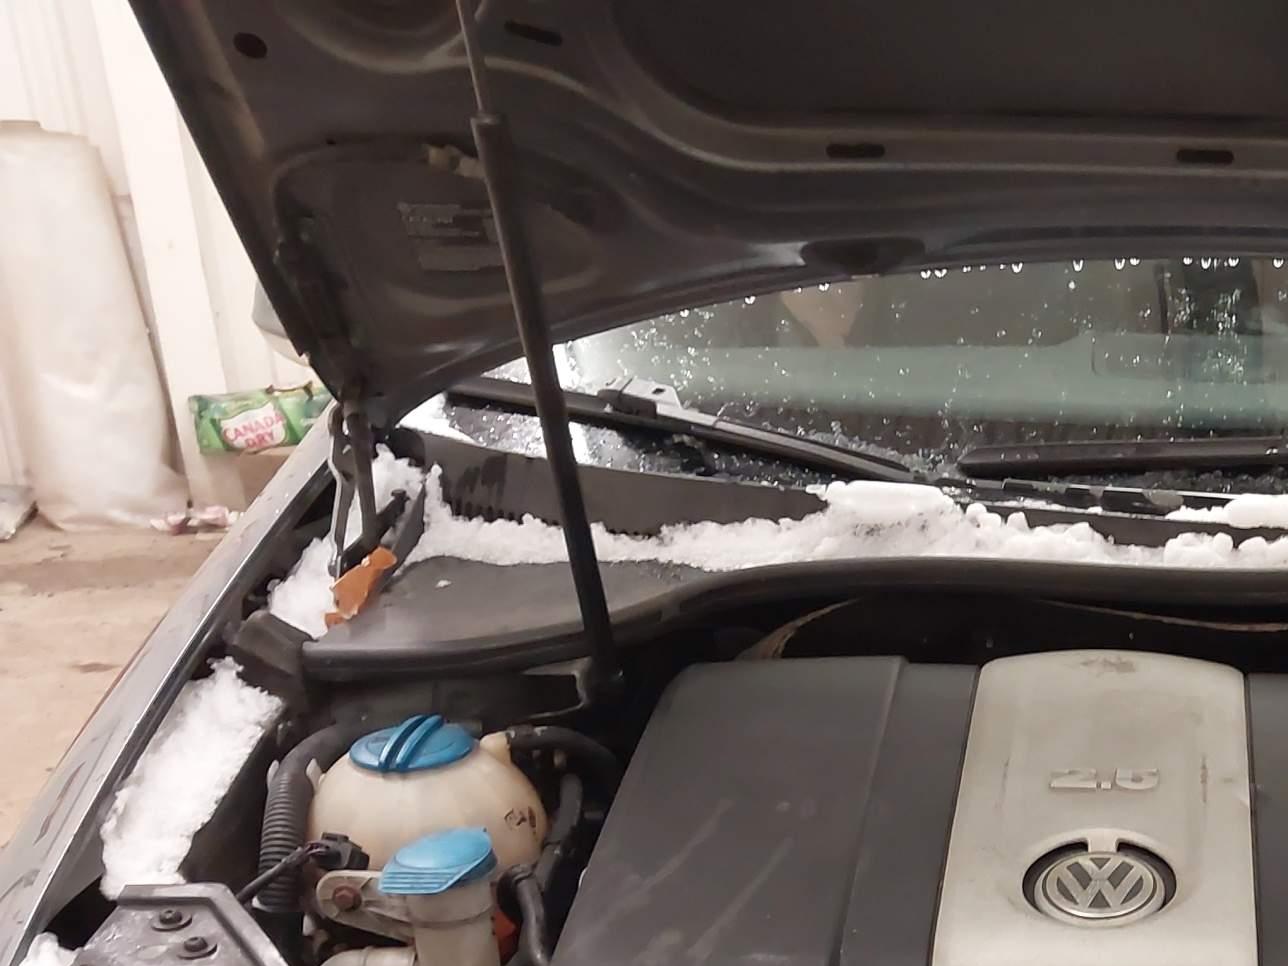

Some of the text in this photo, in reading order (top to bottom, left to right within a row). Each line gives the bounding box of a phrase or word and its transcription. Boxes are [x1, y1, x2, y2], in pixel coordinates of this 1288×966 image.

[223, 413, 285, 441] CANADA
[245, 430, 275, 449] DRY
[1049, 767, 1160, 790] 2.5
[1045, 853, 1155, 917] VW
